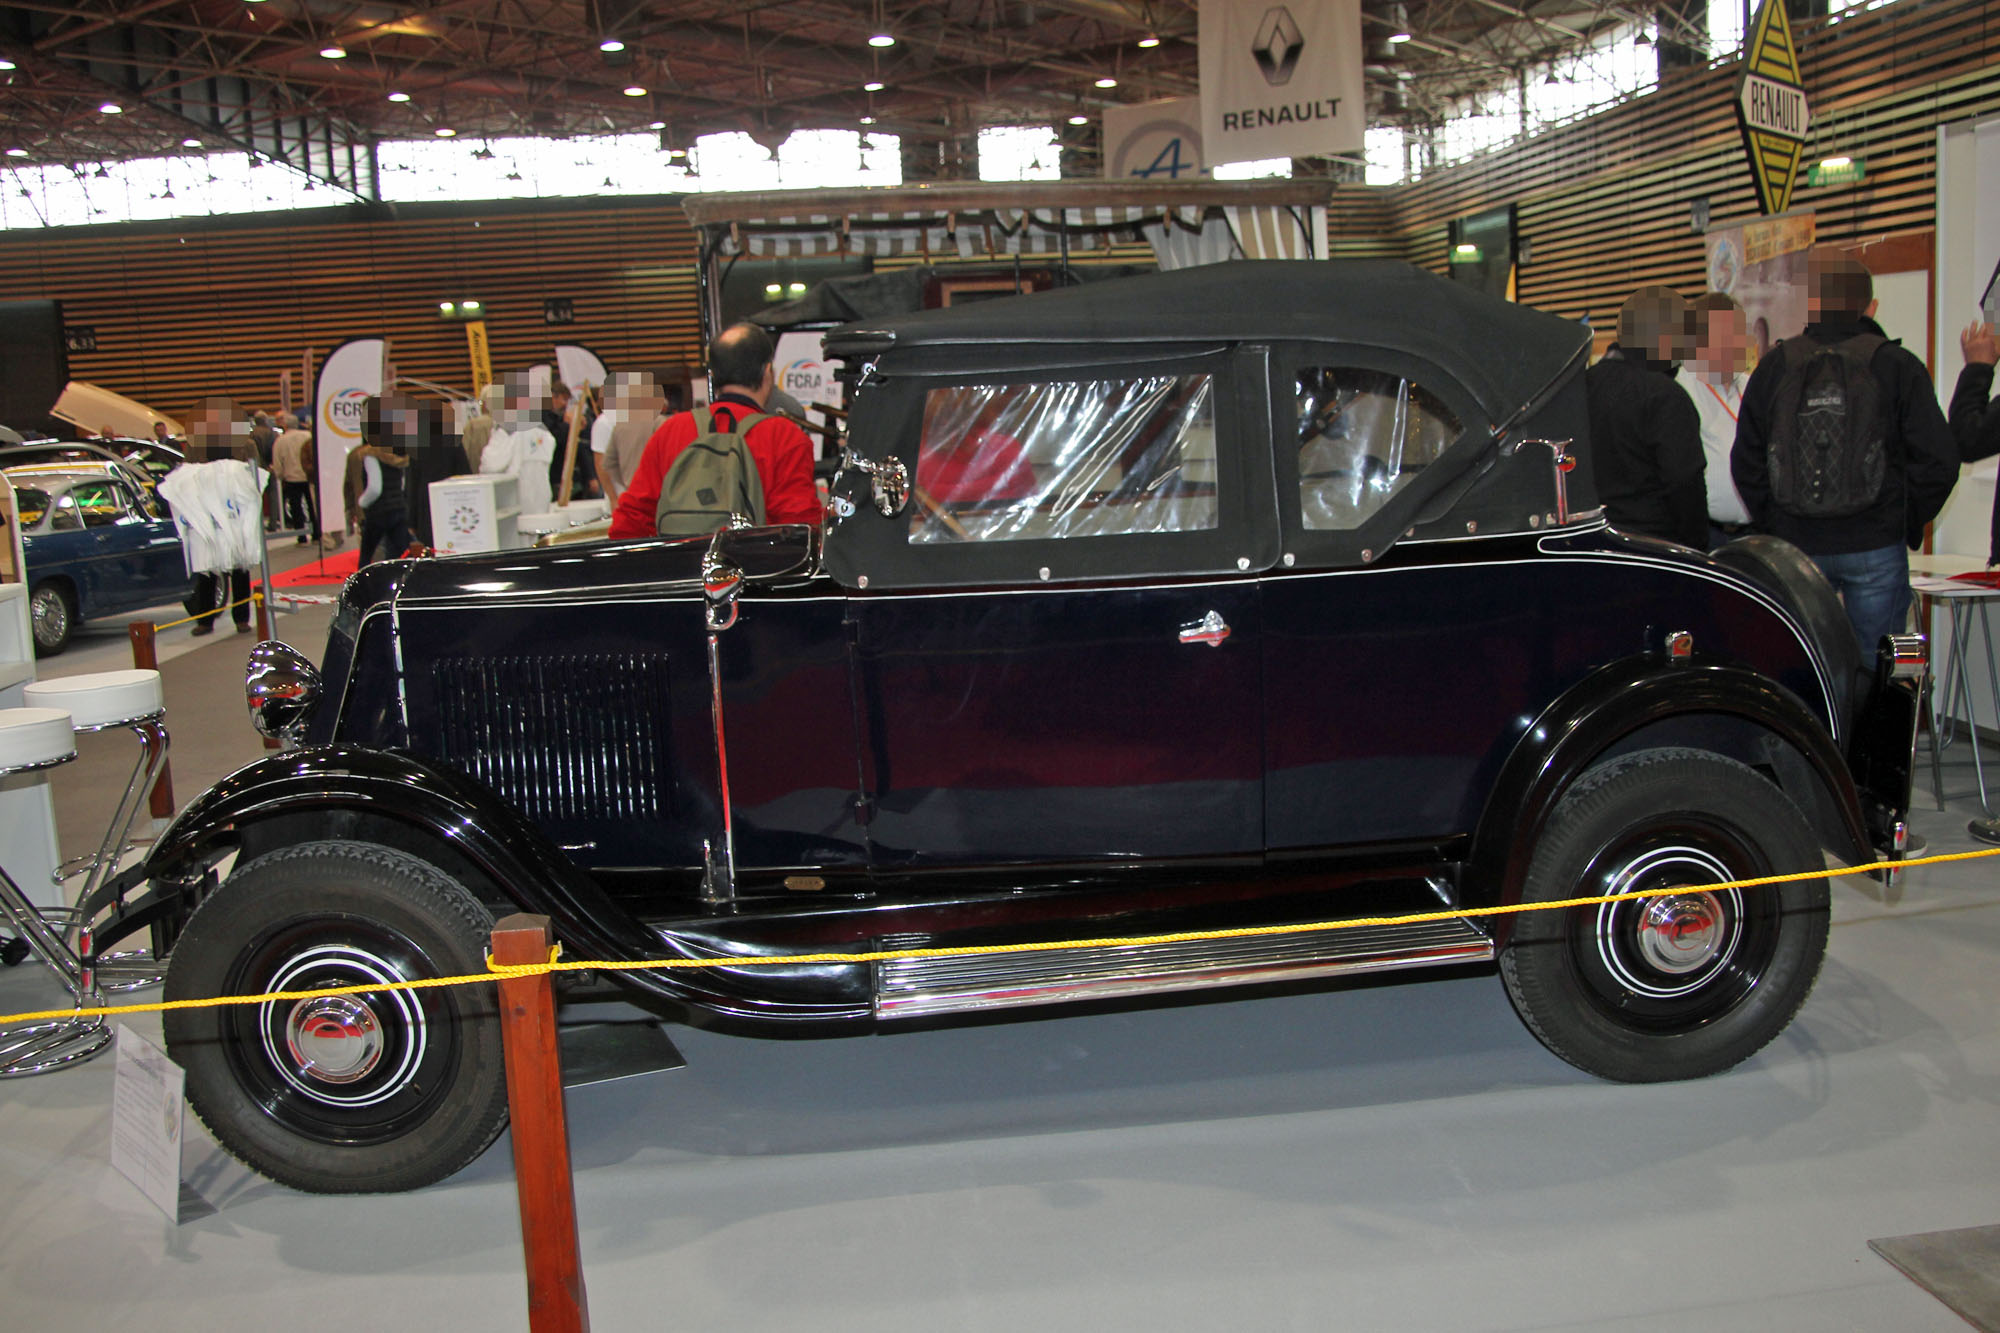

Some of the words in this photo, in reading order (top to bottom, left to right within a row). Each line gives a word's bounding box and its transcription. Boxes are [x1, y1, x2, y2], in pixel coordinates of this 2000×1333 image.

[1223, 98, 1342, 132] RENAULT
[1751, 80, 1801, 133] RENAULT
[786, 373, 822, 389] FCRA
[333, 401, 363, 417] FCR
